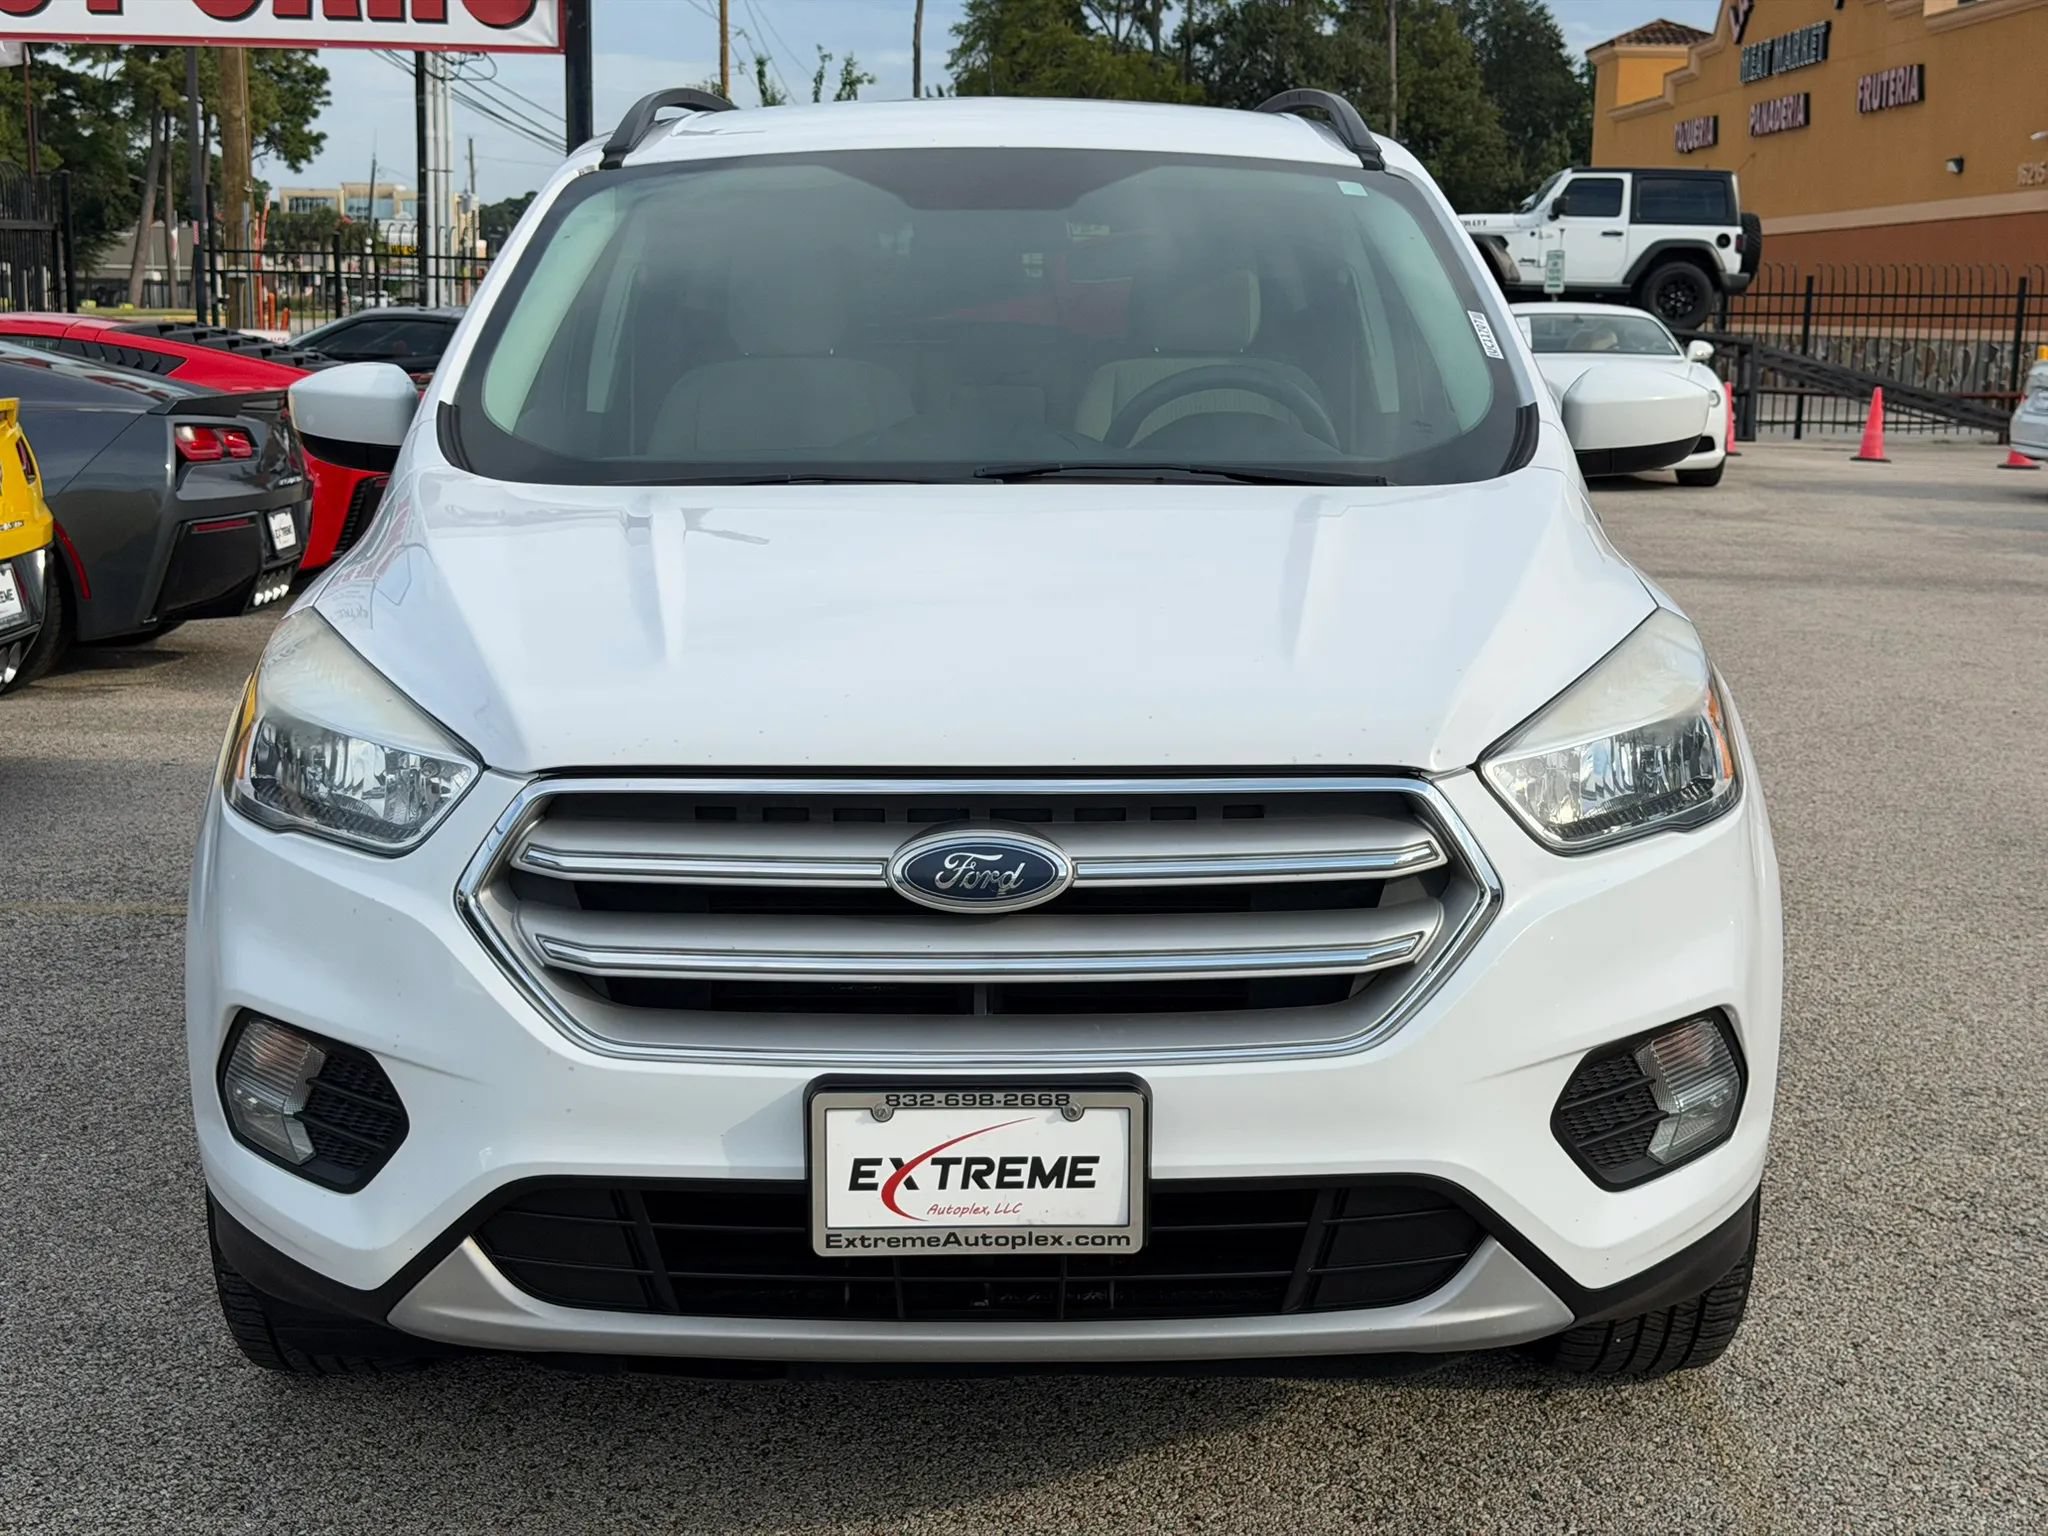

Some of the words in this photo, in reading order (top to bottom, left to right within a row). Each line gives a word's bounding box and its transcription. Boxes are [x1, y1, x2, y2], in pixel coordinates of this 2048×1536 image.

[1741, 37, 1773, 84] MEAT
[1773, 21, 1830, 74] MARKET
[1857, 65, 1922, 113] FRUTERIA
[1750, 93, 1807, 136] PANADERIA
[934, 852, 1026, 891] Ford
[885, 1093, 1071, 1107] 832-698-2668
[848, 1155, 1100, 1191] EXTREME
[926, 1203, 991, 1217] Autoplex,
[993, 1203, 1023, 1214] LLC
[825, 1231, 1131, 1250] ExtremeAutoplex.com
